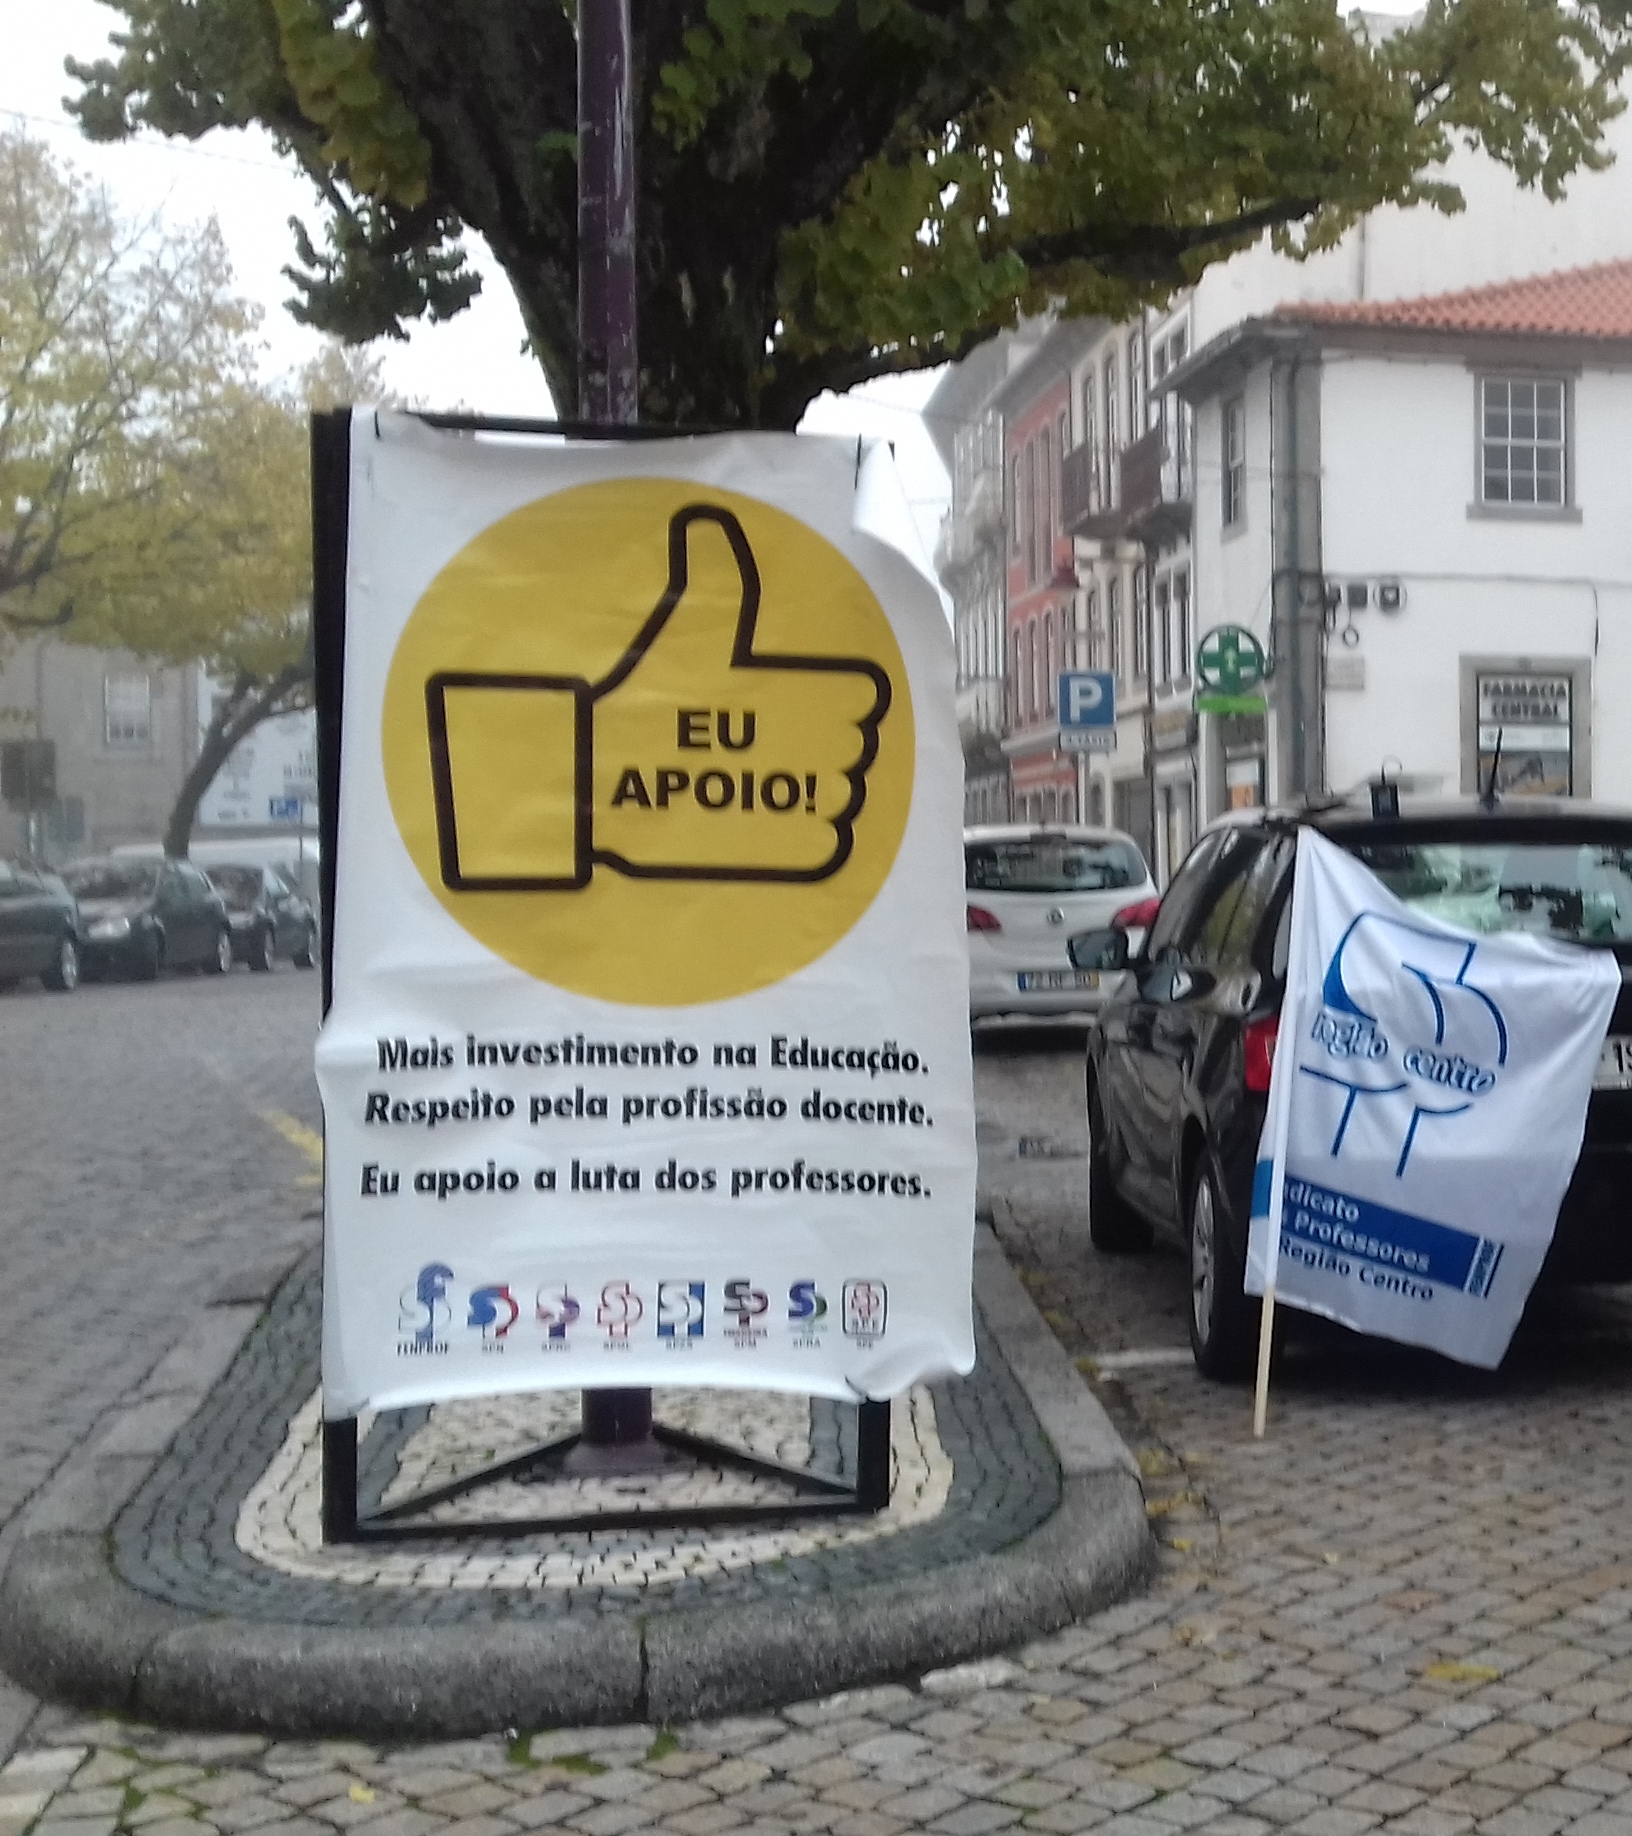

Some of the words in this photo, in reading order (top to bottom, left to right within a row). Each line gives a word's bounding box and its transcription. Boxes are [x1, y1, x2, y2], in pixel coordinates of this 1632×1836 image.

[1069, 675, 1103, 723] P
[676, 708, 757, 752] EU
[611, 765, 818, 815] APOIO!
[376, 1035, 454, 1072] Mais
[466, 1032, 699, 1069] investimento
[712, 1042, 758, 1069] na
[769, 1033, 930, 1080] Educação.
[363, 1086, 517, 1131] Respeito
[529, 1084, 609, 1127] pela
[622, 1084, 788, 1127] profissão
[800, 1086, 934, 1128] docente.
[360, 1160, 400, 1198] Eu
[413, 1158, 520, 1202] apoio
[535, 1168, 558, 1193] a
[570, 1157, 642, 1194] luta
[654, 1157, 719, 1193] dos
[730, 1157, 932, 1200] professores.
[1293, 1208, 1431, 1273] Professores
[1357, 1262, 1434, 1301] Centro
